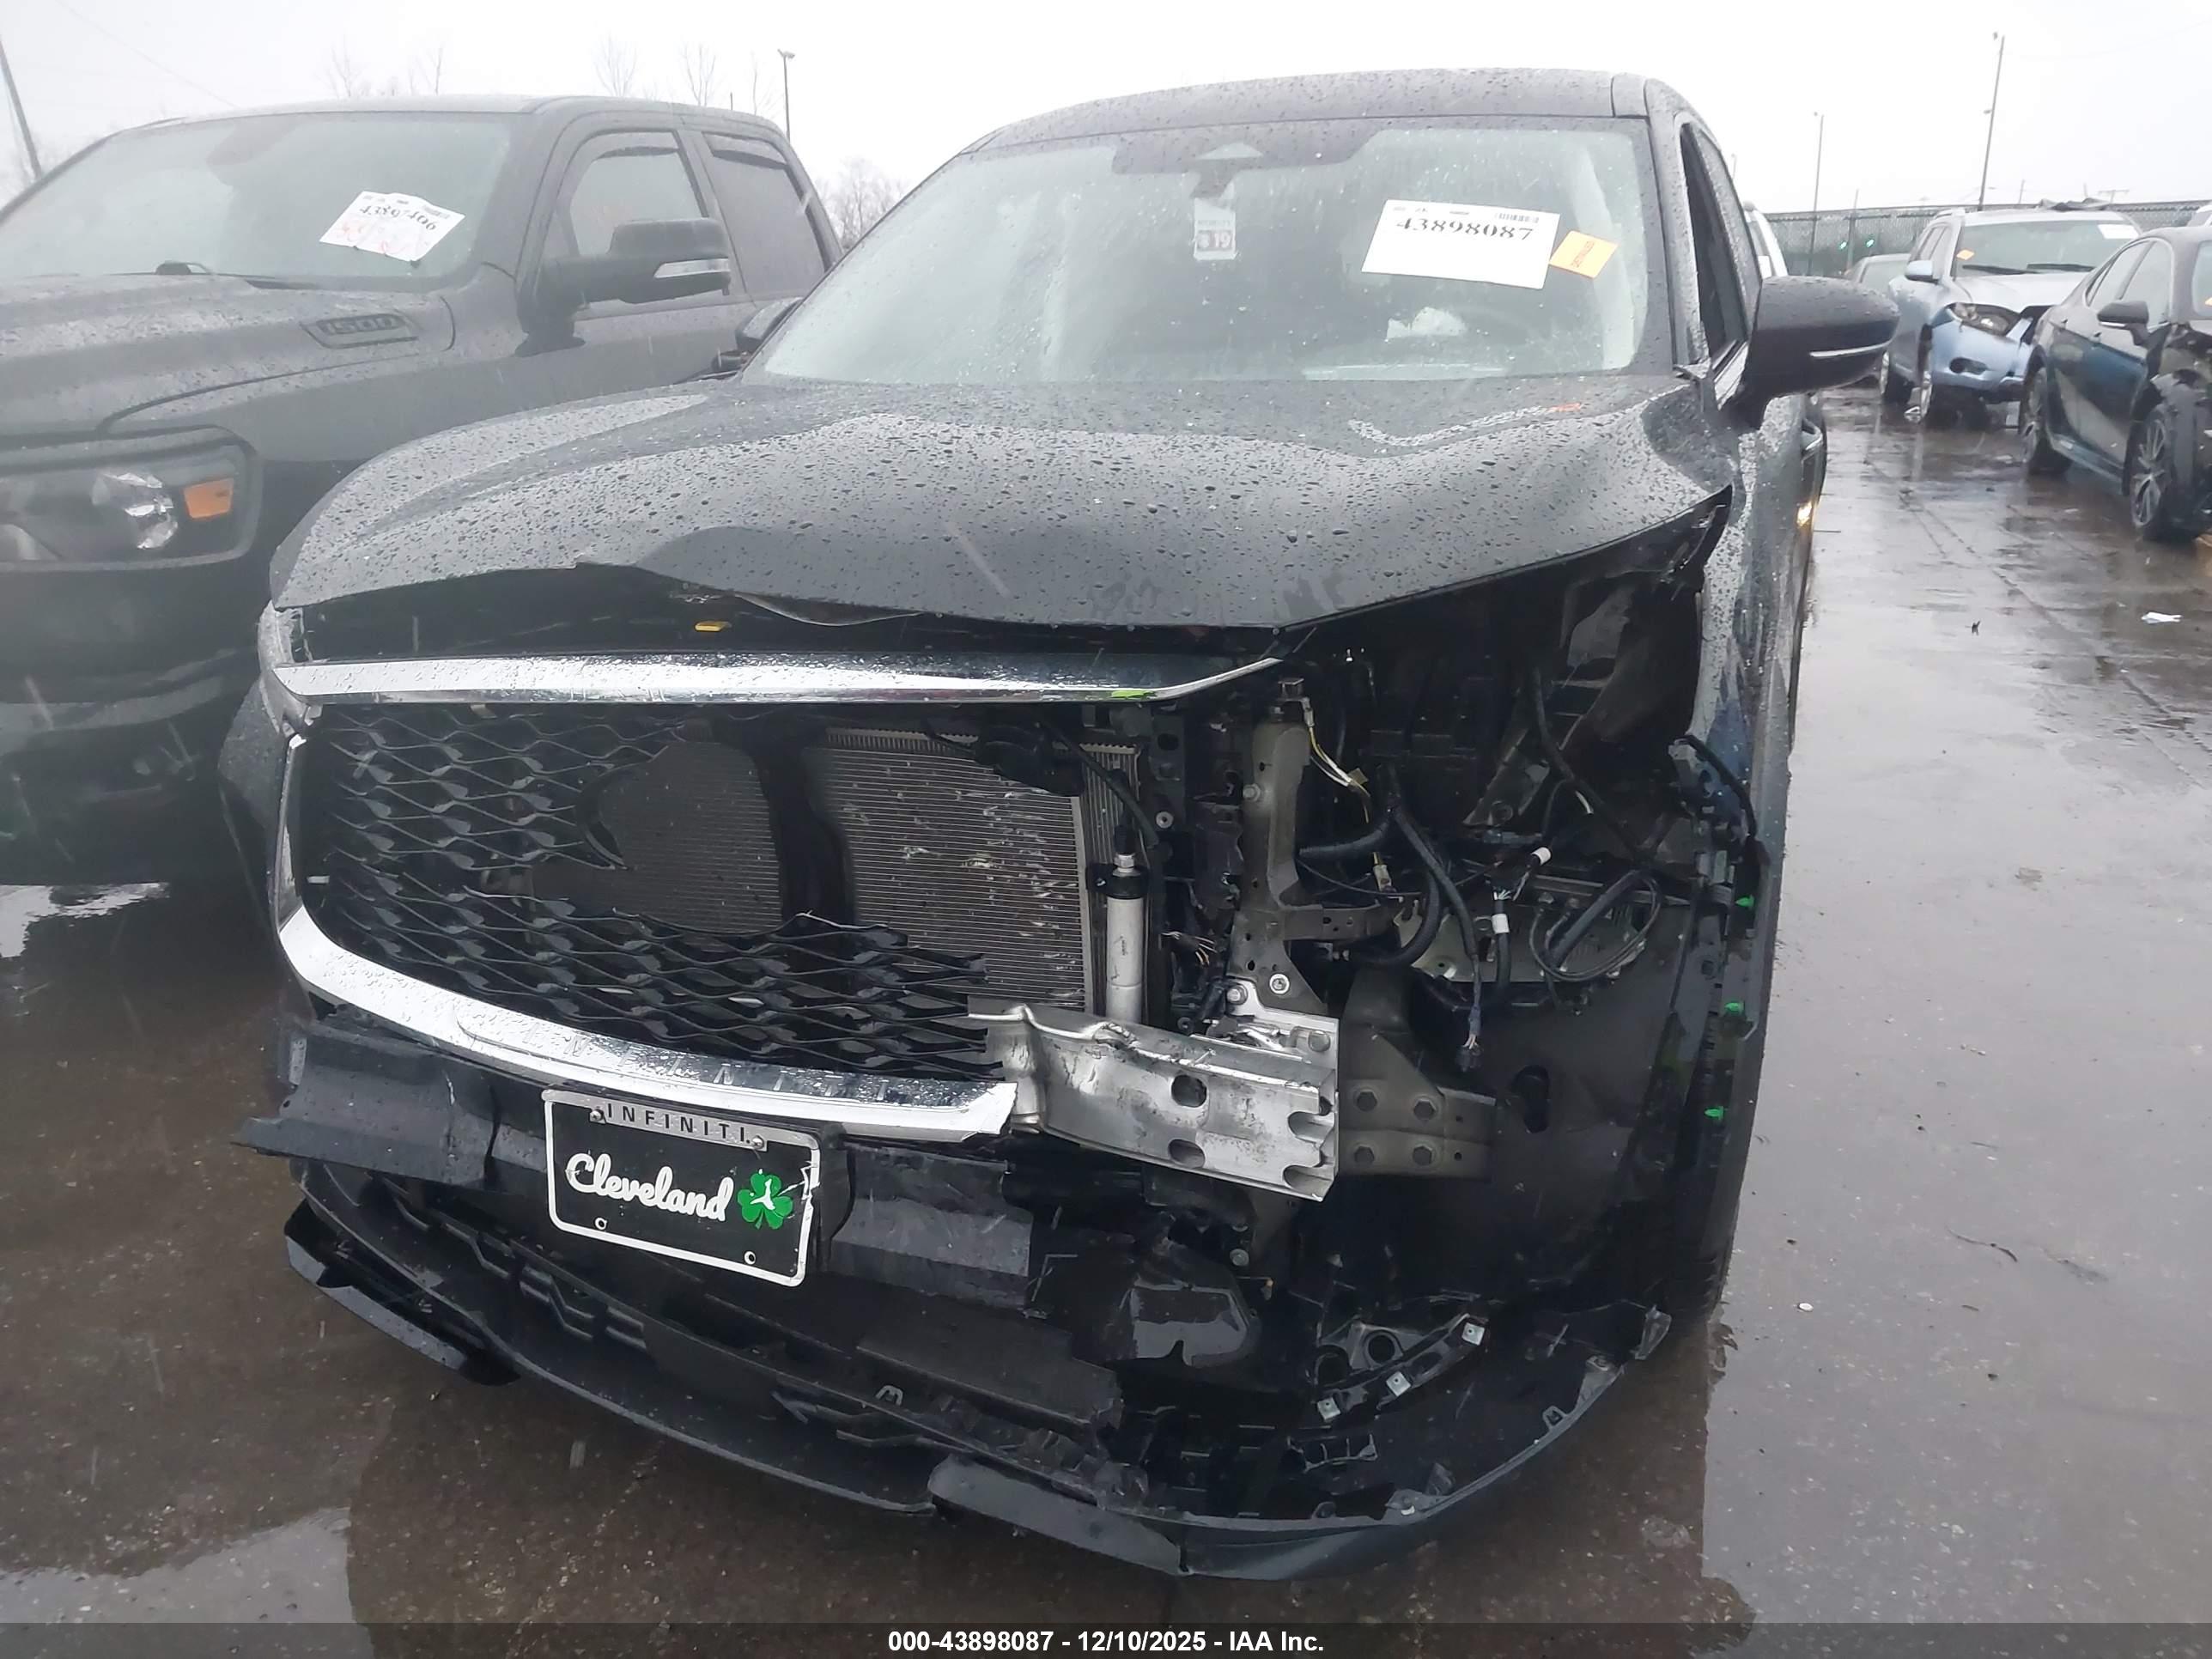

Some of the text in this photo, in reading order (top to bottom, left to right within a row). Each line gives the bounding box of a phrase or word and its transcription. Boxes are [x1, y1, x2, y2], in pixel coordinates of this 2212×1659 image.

[1396, 217, 1534, 240] 43898087
[325, 317, 397, 335] 1500
[607, 1103, 745, 1143] INFINITI
[564, 1152, 735, 1222] Cleveland
